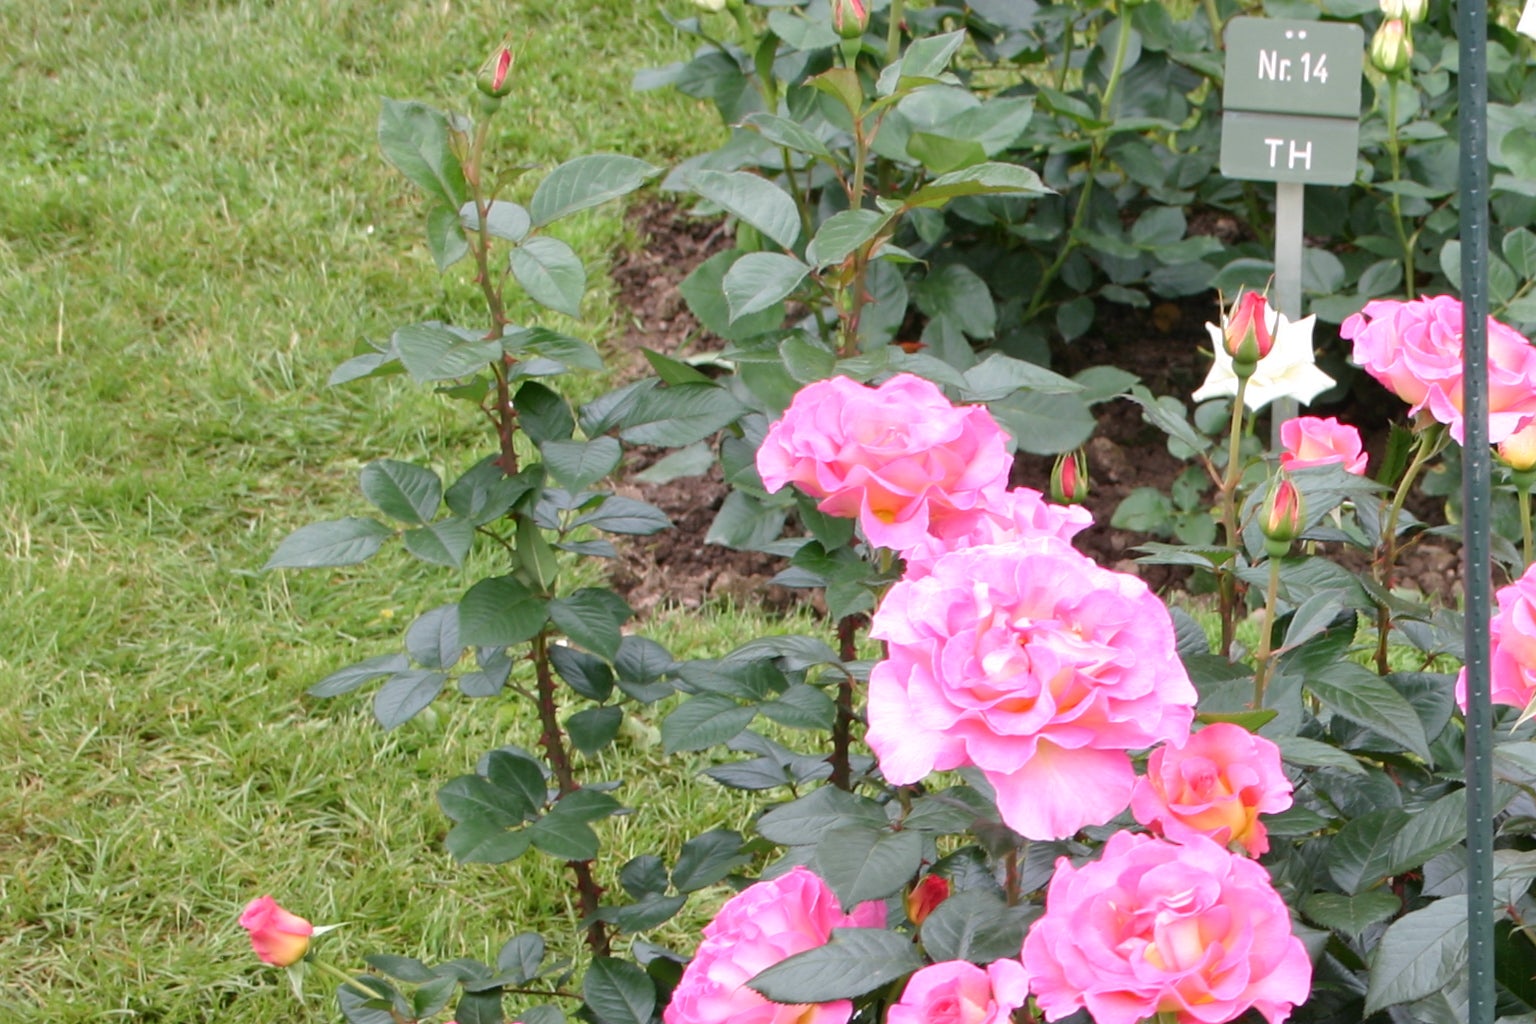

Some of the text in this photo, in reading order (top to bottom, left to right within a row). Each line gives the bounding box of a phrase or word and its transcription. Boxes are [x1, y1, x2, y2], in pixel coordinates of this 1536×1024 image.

[1257, 48, 1329, 84] Nr. 14
[1263, 137, 1313, 171] TH
